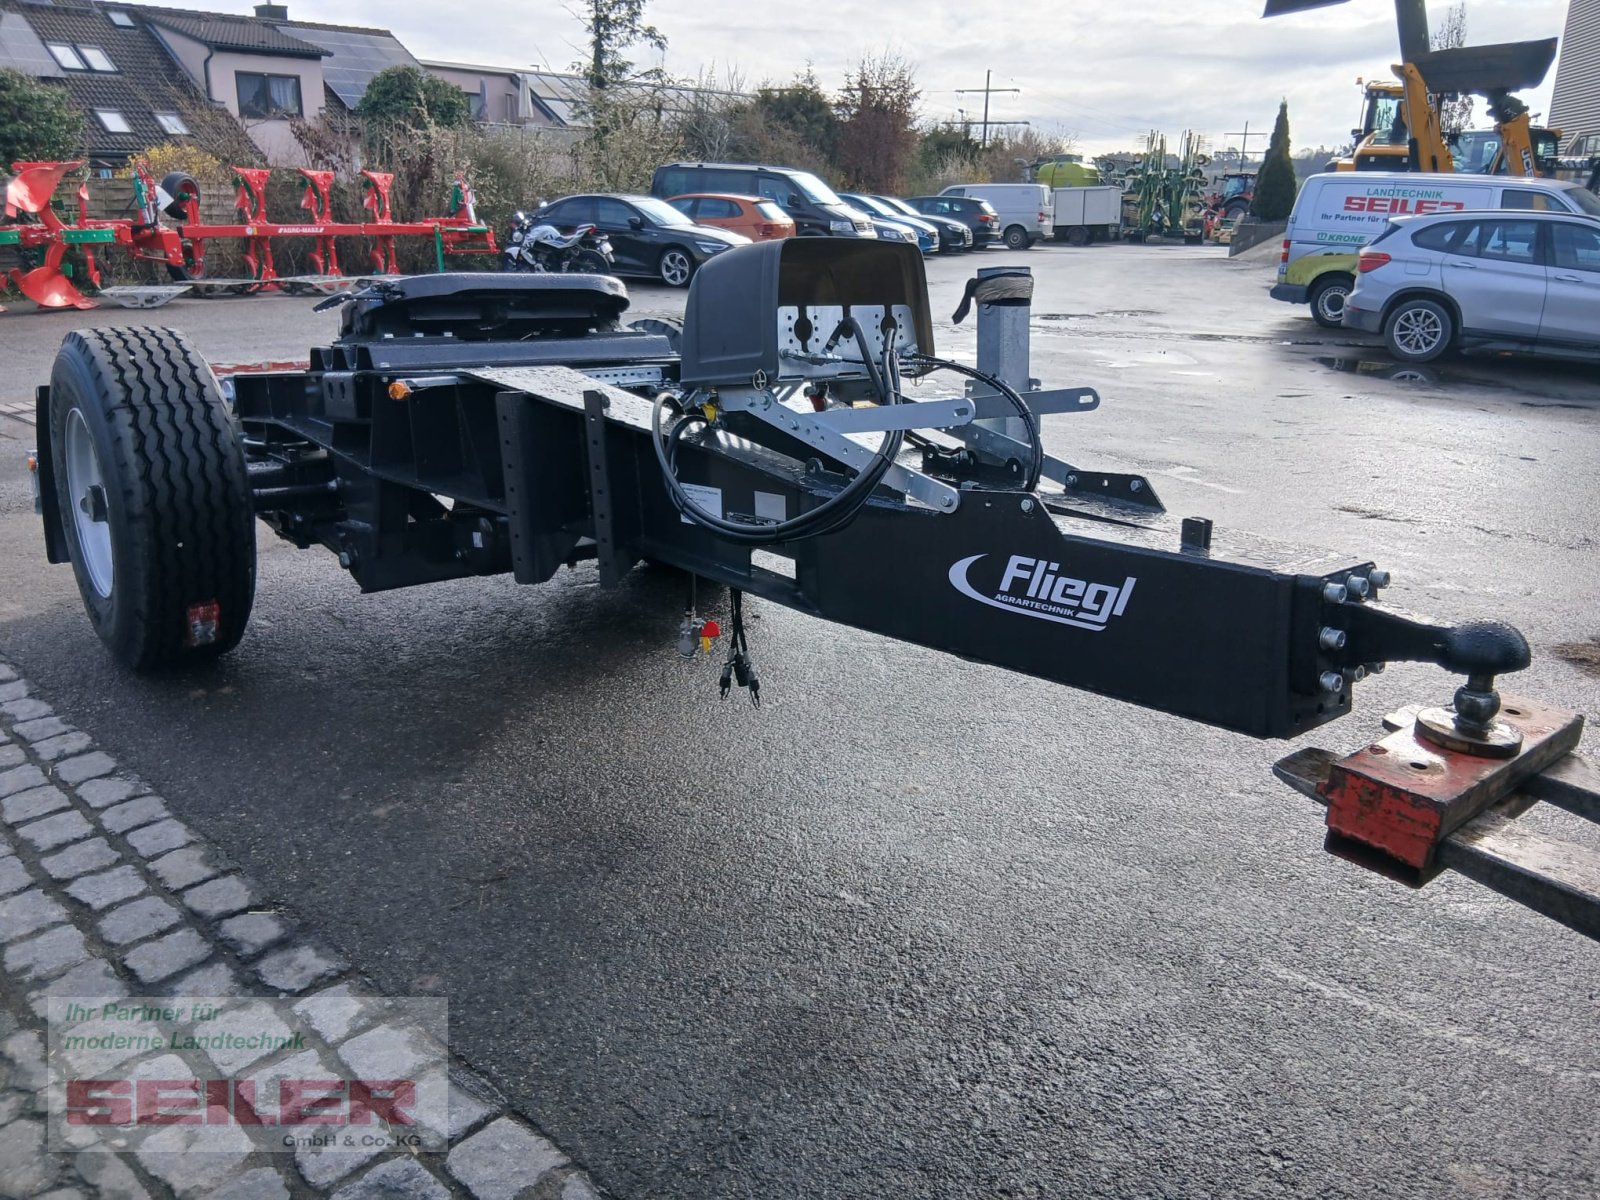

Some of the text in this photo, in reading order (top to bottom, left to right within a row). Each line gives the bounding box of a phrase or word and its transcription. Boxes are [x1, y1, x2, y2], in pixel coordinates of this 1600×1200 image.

[1366, 188, 1444, 199] LANDTECHNIK
[1334, 214, 1365, 222] Partner
[1327, 234, 1367, 243] KRONE
[999, 554, 1137, 624] Fliegl
[994, 593, 1075, 617] AGRARTECHNIK
